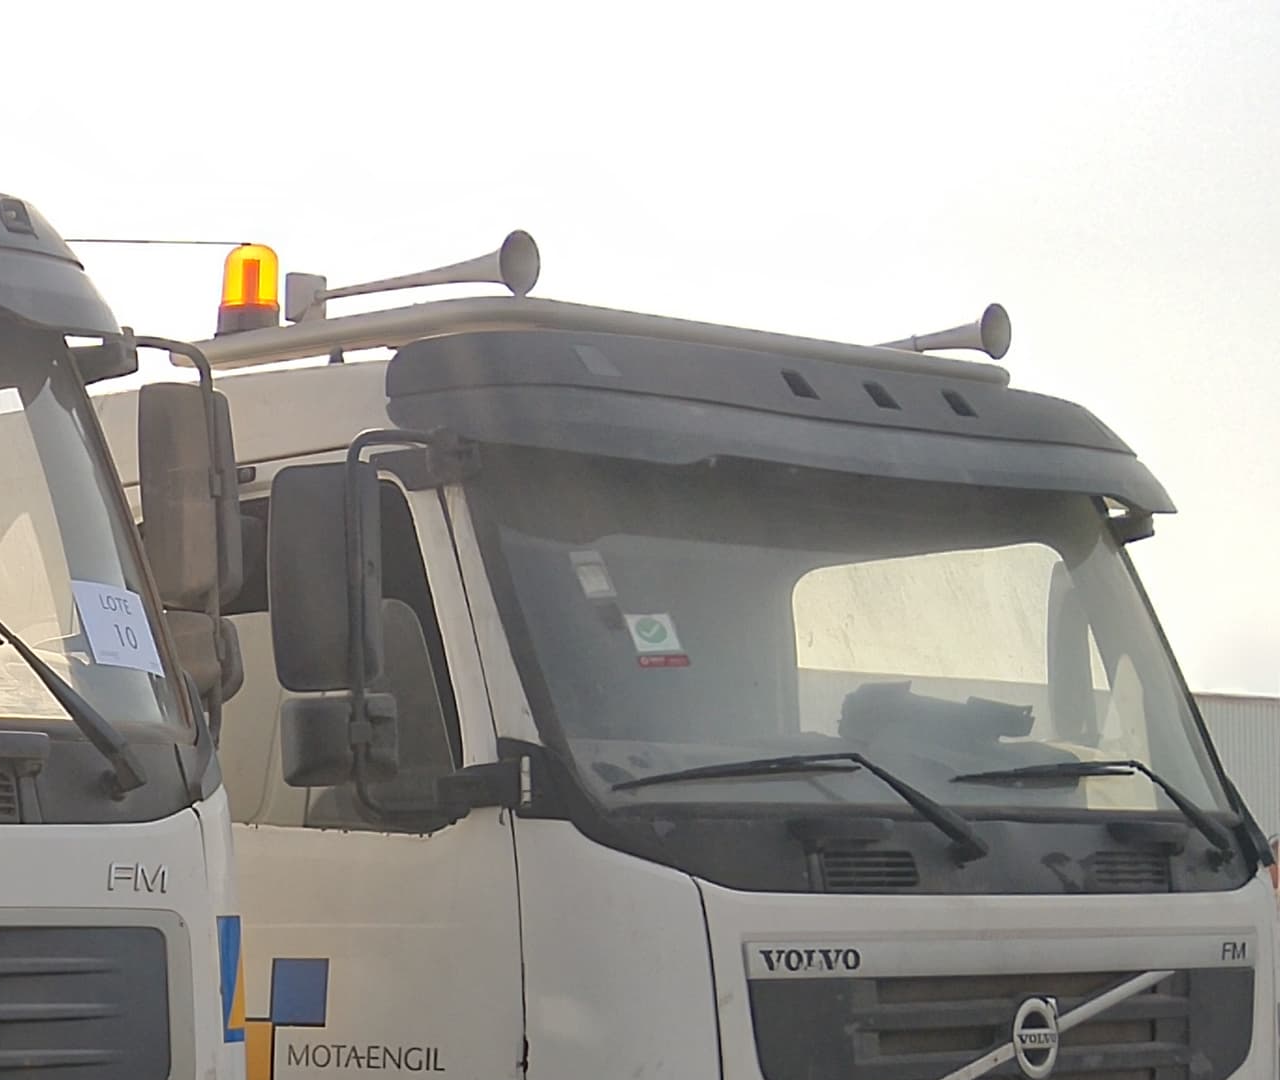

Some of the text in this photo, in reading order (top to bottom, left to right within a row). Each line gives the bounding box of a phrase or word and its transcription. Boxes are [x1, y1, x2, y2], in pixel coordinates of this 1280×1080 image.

[99, 593, 132, 615] LOTE
[114, 624, 138, 650] 10
[107, 862, 168, 894] FM
[759, 948, 861, 971] VOLVO
[1222, 942, 1246, 961] FM
